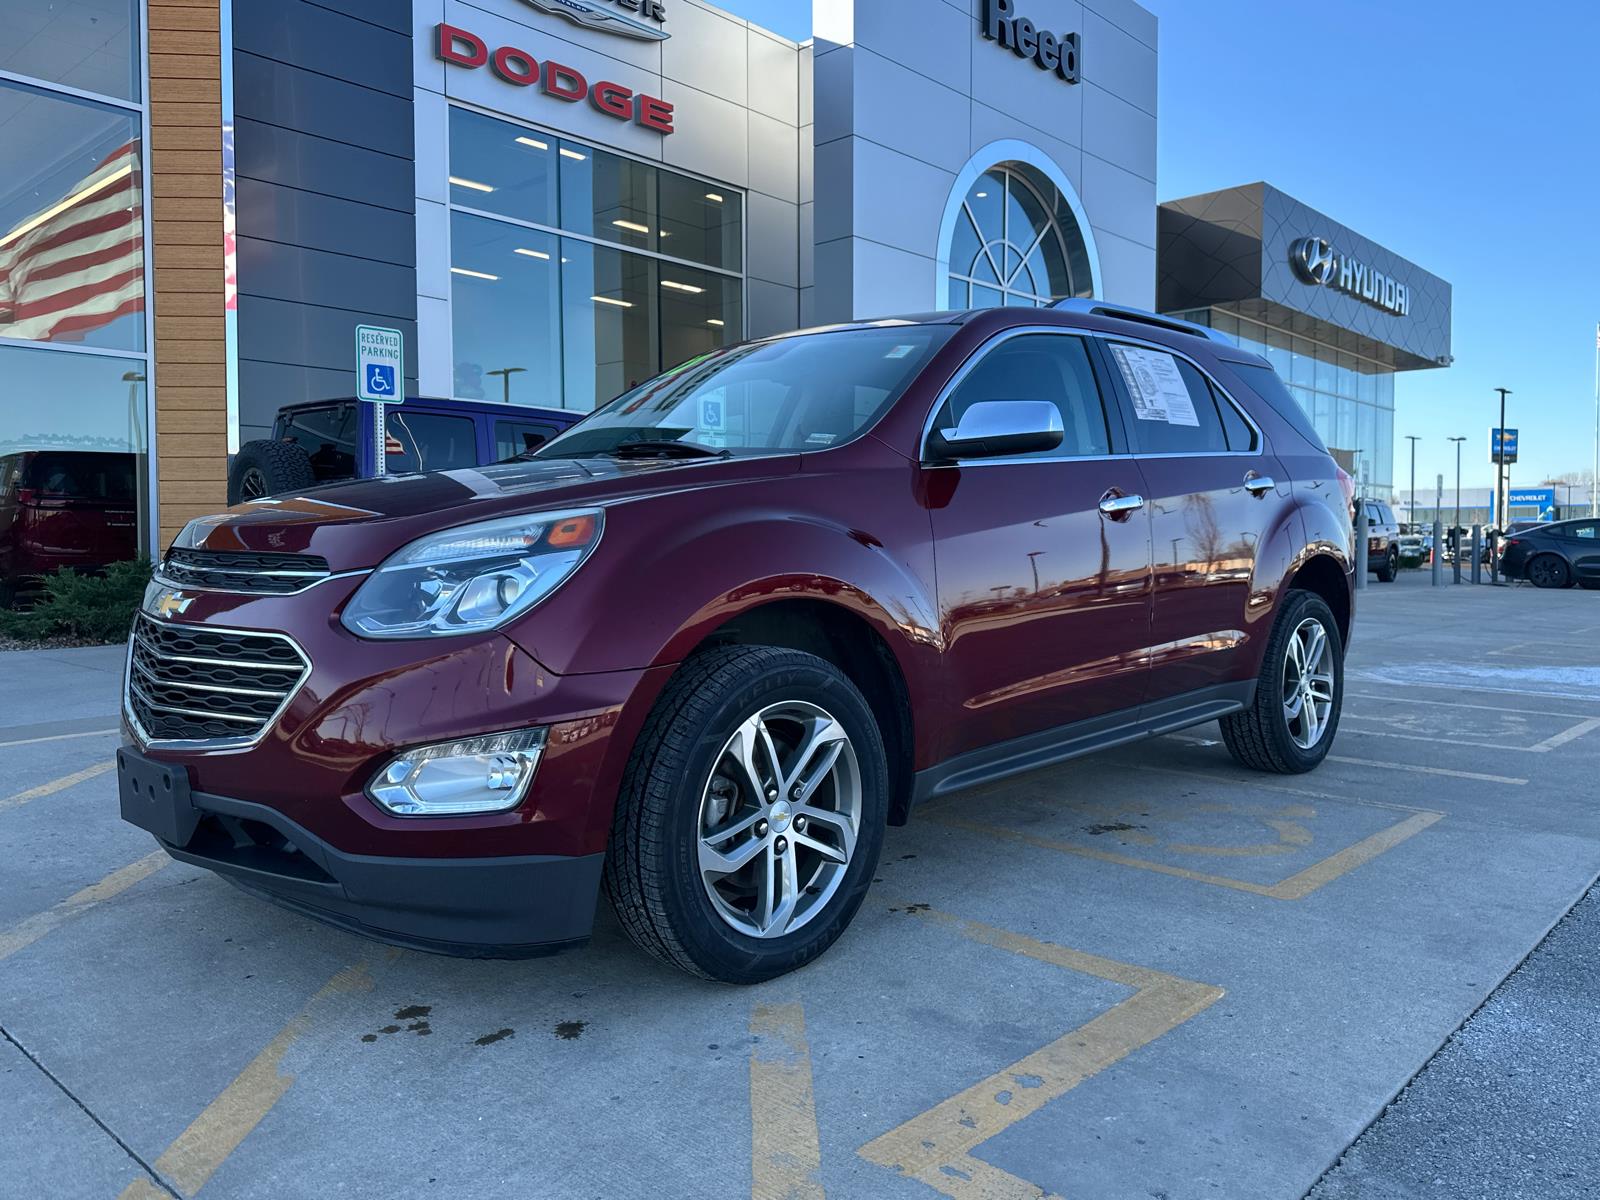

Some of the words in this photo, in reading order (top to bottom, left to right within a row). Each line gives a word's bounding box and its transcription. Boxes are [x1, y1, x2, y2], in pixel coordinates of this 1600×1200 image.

[982, 0, 1081, 85] Reed
[435, 22, 674, 136] DODGE
[1340, 254, 1410, 316] HYUNDAI
[361, 332, 398, 347] RESERVED
[361, 346, 399, 360] PARKING
